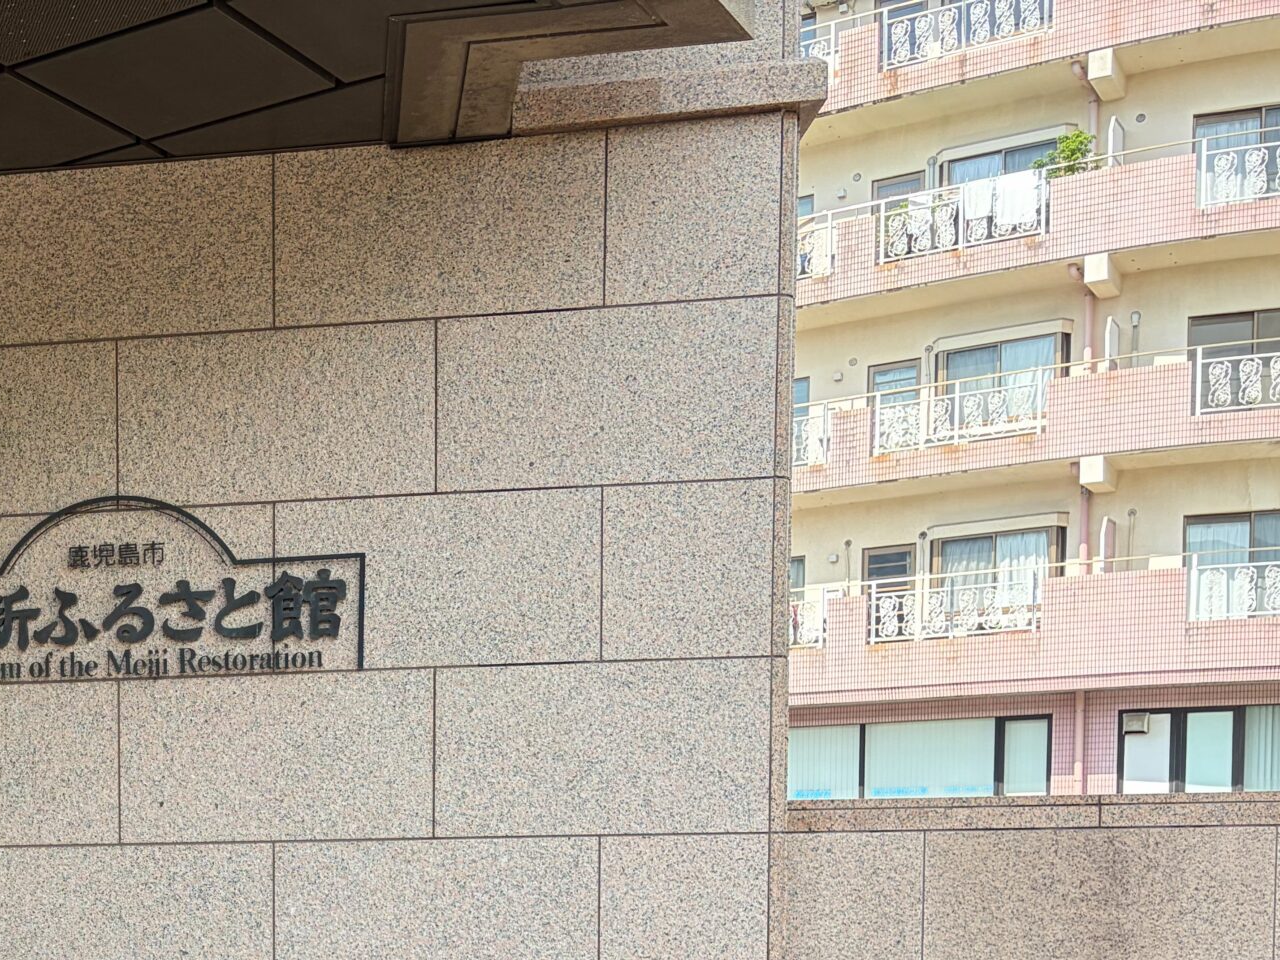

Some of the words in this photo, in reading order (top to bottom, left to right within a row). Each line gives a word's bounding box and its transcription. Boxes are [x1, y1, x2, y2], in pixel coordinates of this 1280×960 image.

[67, 541, 165, 568] 鹿児島市
[30, 652, 53, 677] of
[59, 651, 98, 677] the
[107, 648, 168, 679] Meiji
[179, 644, 323, 674] Restoration
